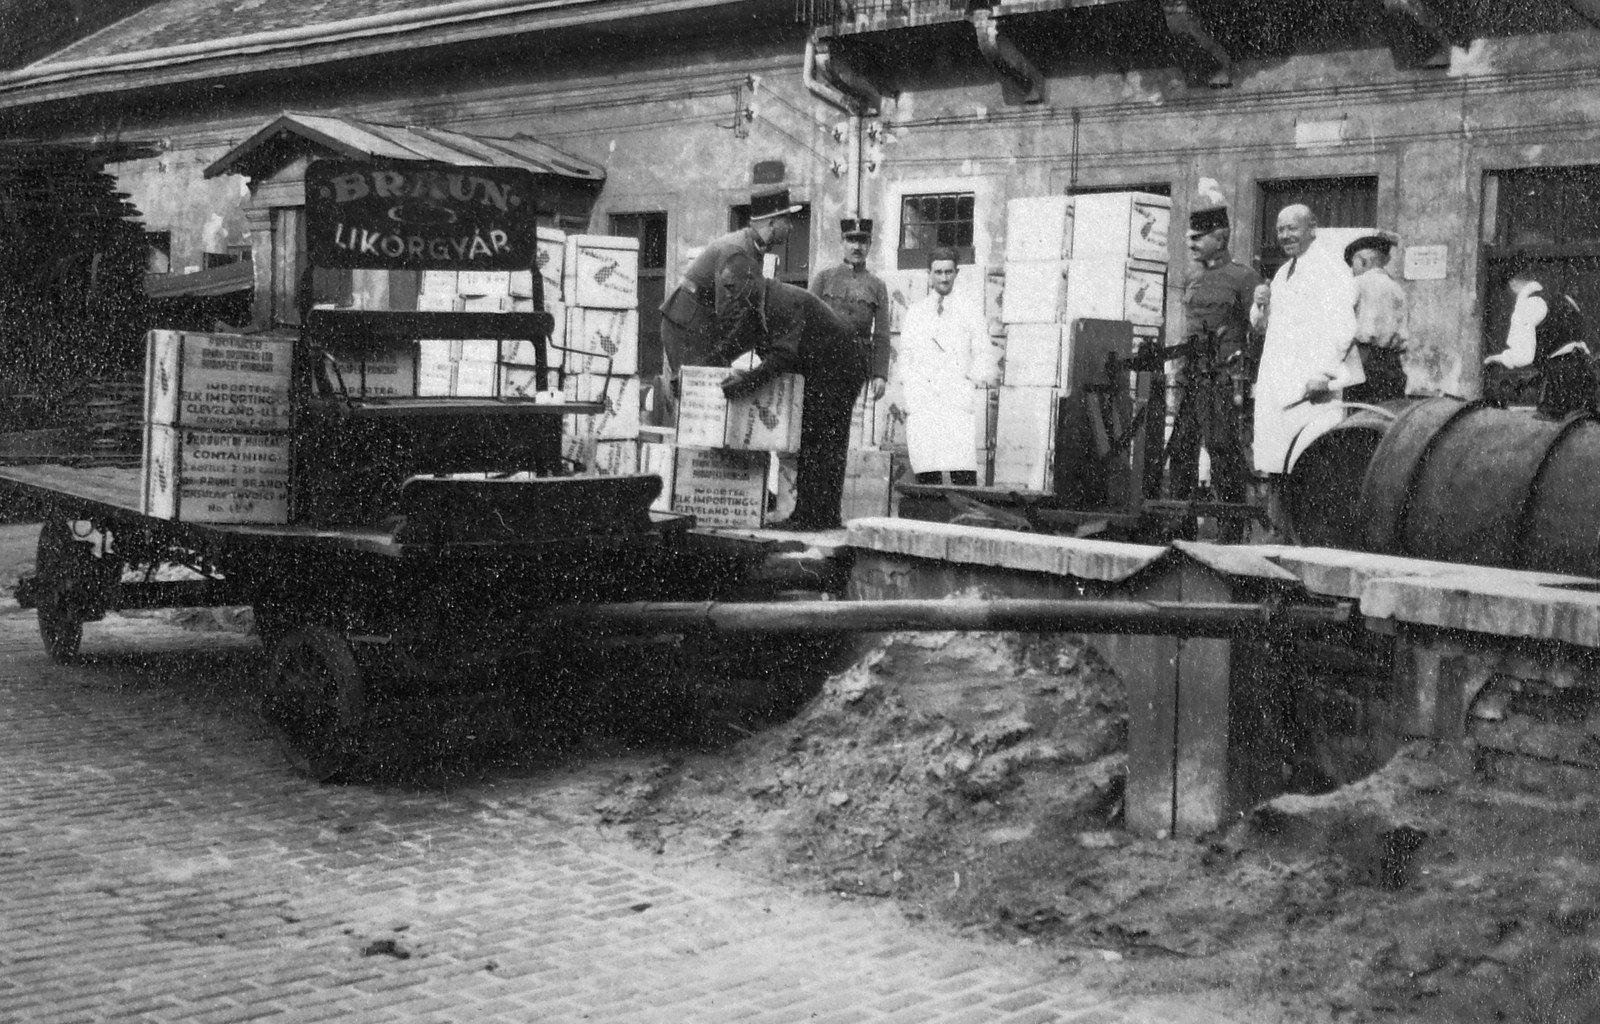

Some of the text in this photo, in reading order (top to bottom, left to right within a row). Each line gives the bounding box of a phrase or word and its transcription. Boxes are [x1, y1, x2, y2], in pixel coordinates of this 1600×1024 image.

[331, 170, 511, 213] BRAUN
[183, 391, 202, 402] ELK
[205, 393, 274, 405] IMPORTING
[199, 477, 237, 488] PRUNE
[242, 479, 290, 490] BRANDY
[693, 495, 748, 506] IMPORTING
